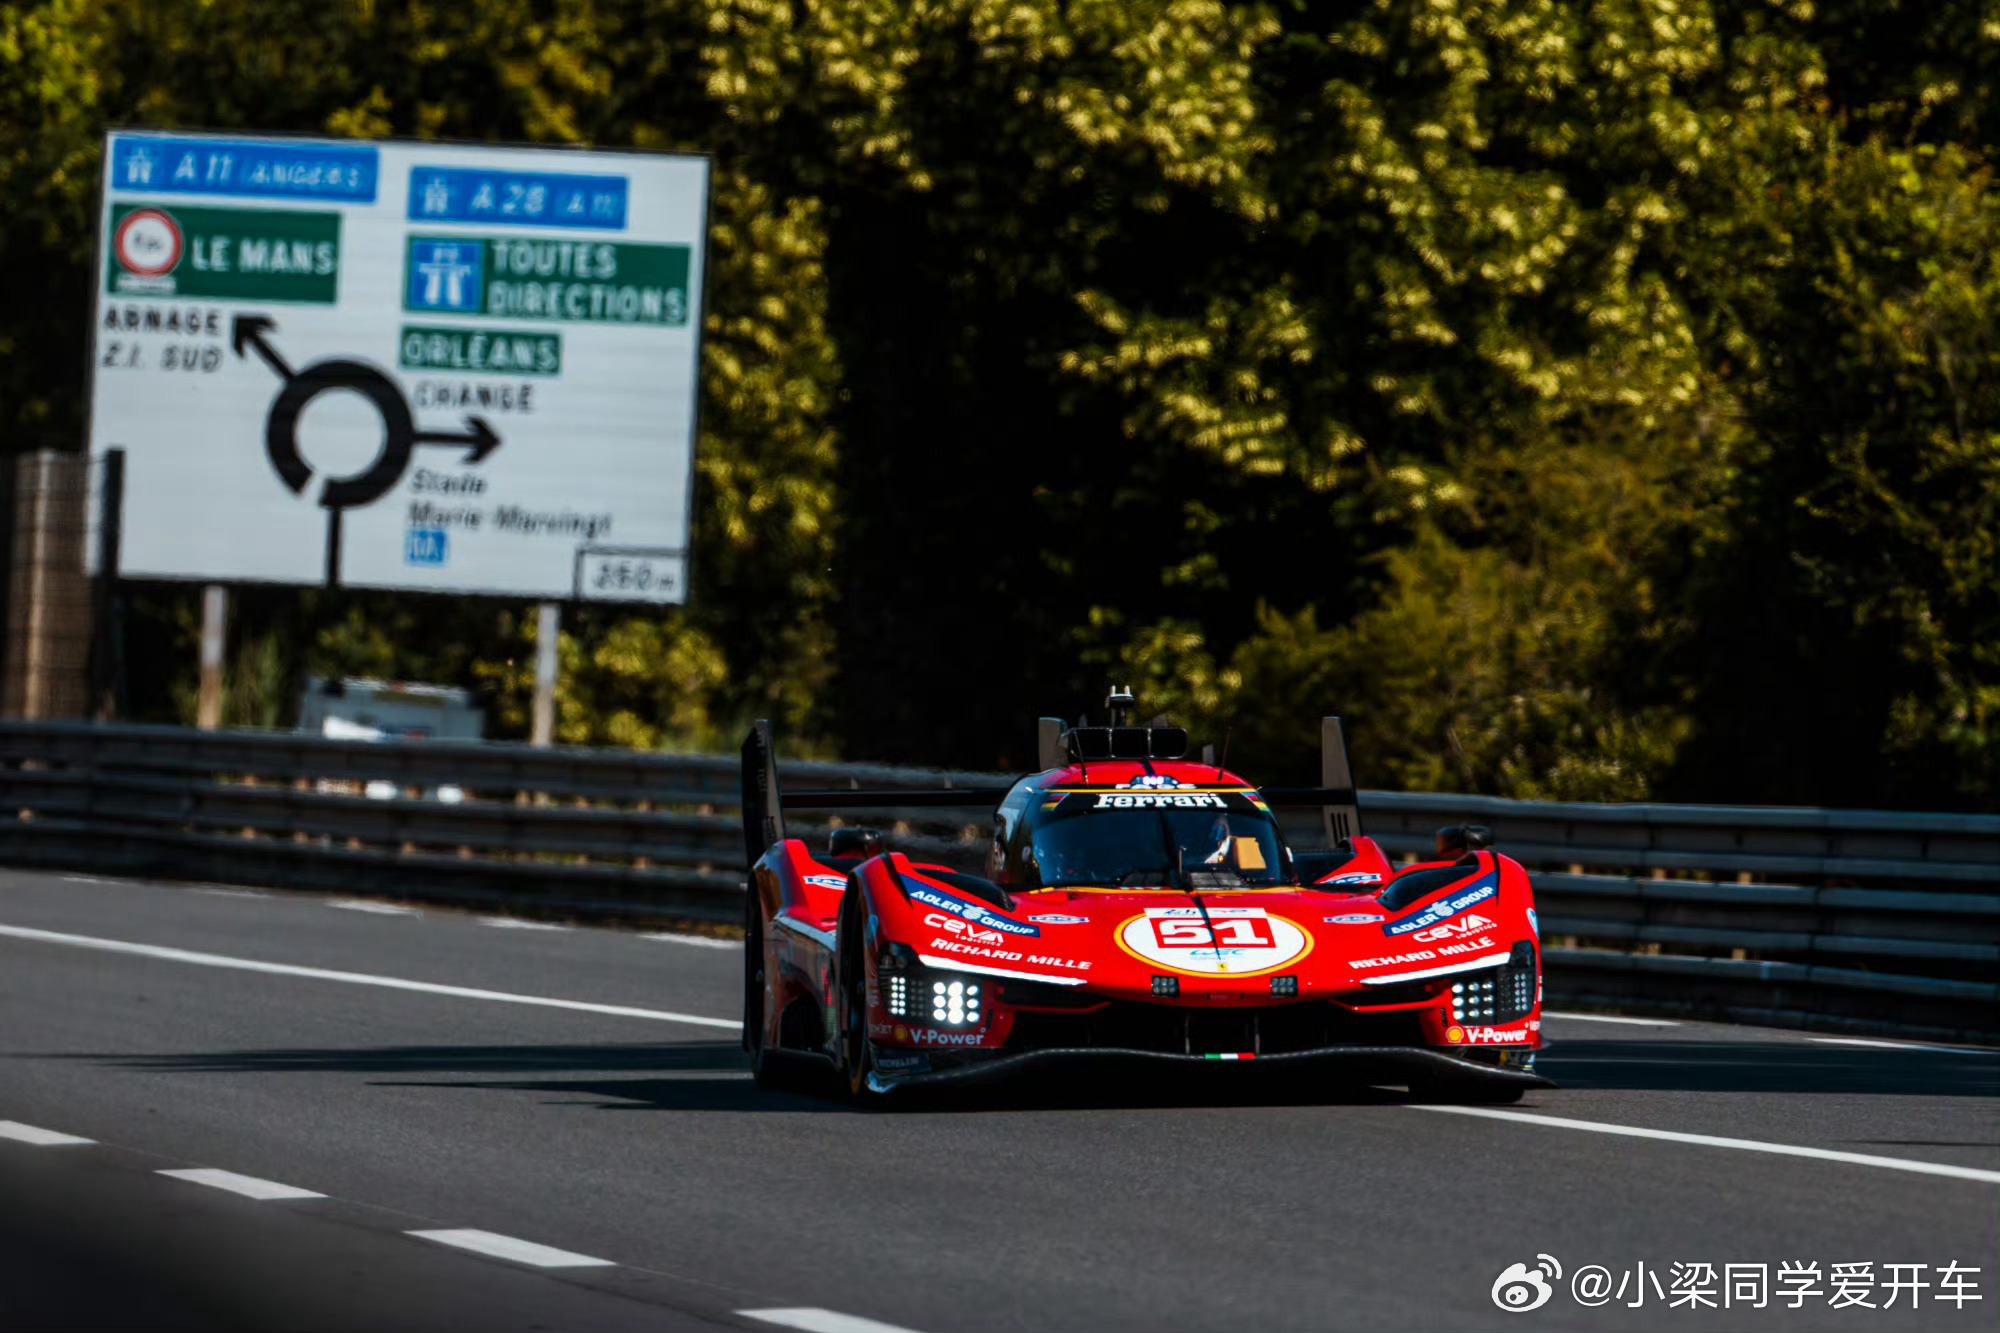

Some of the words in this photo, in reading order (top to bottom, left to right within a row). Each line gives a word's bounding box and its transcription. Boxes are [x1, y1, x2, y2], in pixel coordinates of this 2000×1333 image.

[175, 152, 196, 181] A
[471, 182, 495, 211] A
[191, 236, 232, 272] LE
[238, 237, 336, 275] MANS
[491, 240, 618, 280] TOUTES
[487, 280, 686, 323] DIRECTIONS
[103, 305, 222, 336] ARNAGE
[160, 342, 225, 373] SUD
[1093, 792, 1228, 808] Ferrari
[910, 890, 963, 913] ADLER
[980, 916, 1035, 934] GROUP
[1390, 913, 1440, 935] ADLER
[1450, 886, 1494, 910] GROUP
[1159, 919, 1269, 945] 51
[930, 938, 1022, 961] RICHARD
[1026, 955, 1092, 970] MILLE
[1348, 950, 1437, 970] RICHARD
[1437, 936, 1496, 956] MILLE
[910, 1028, 985, 1046] V-Power
[1466, 1027, 1528, 1043] V-Power
